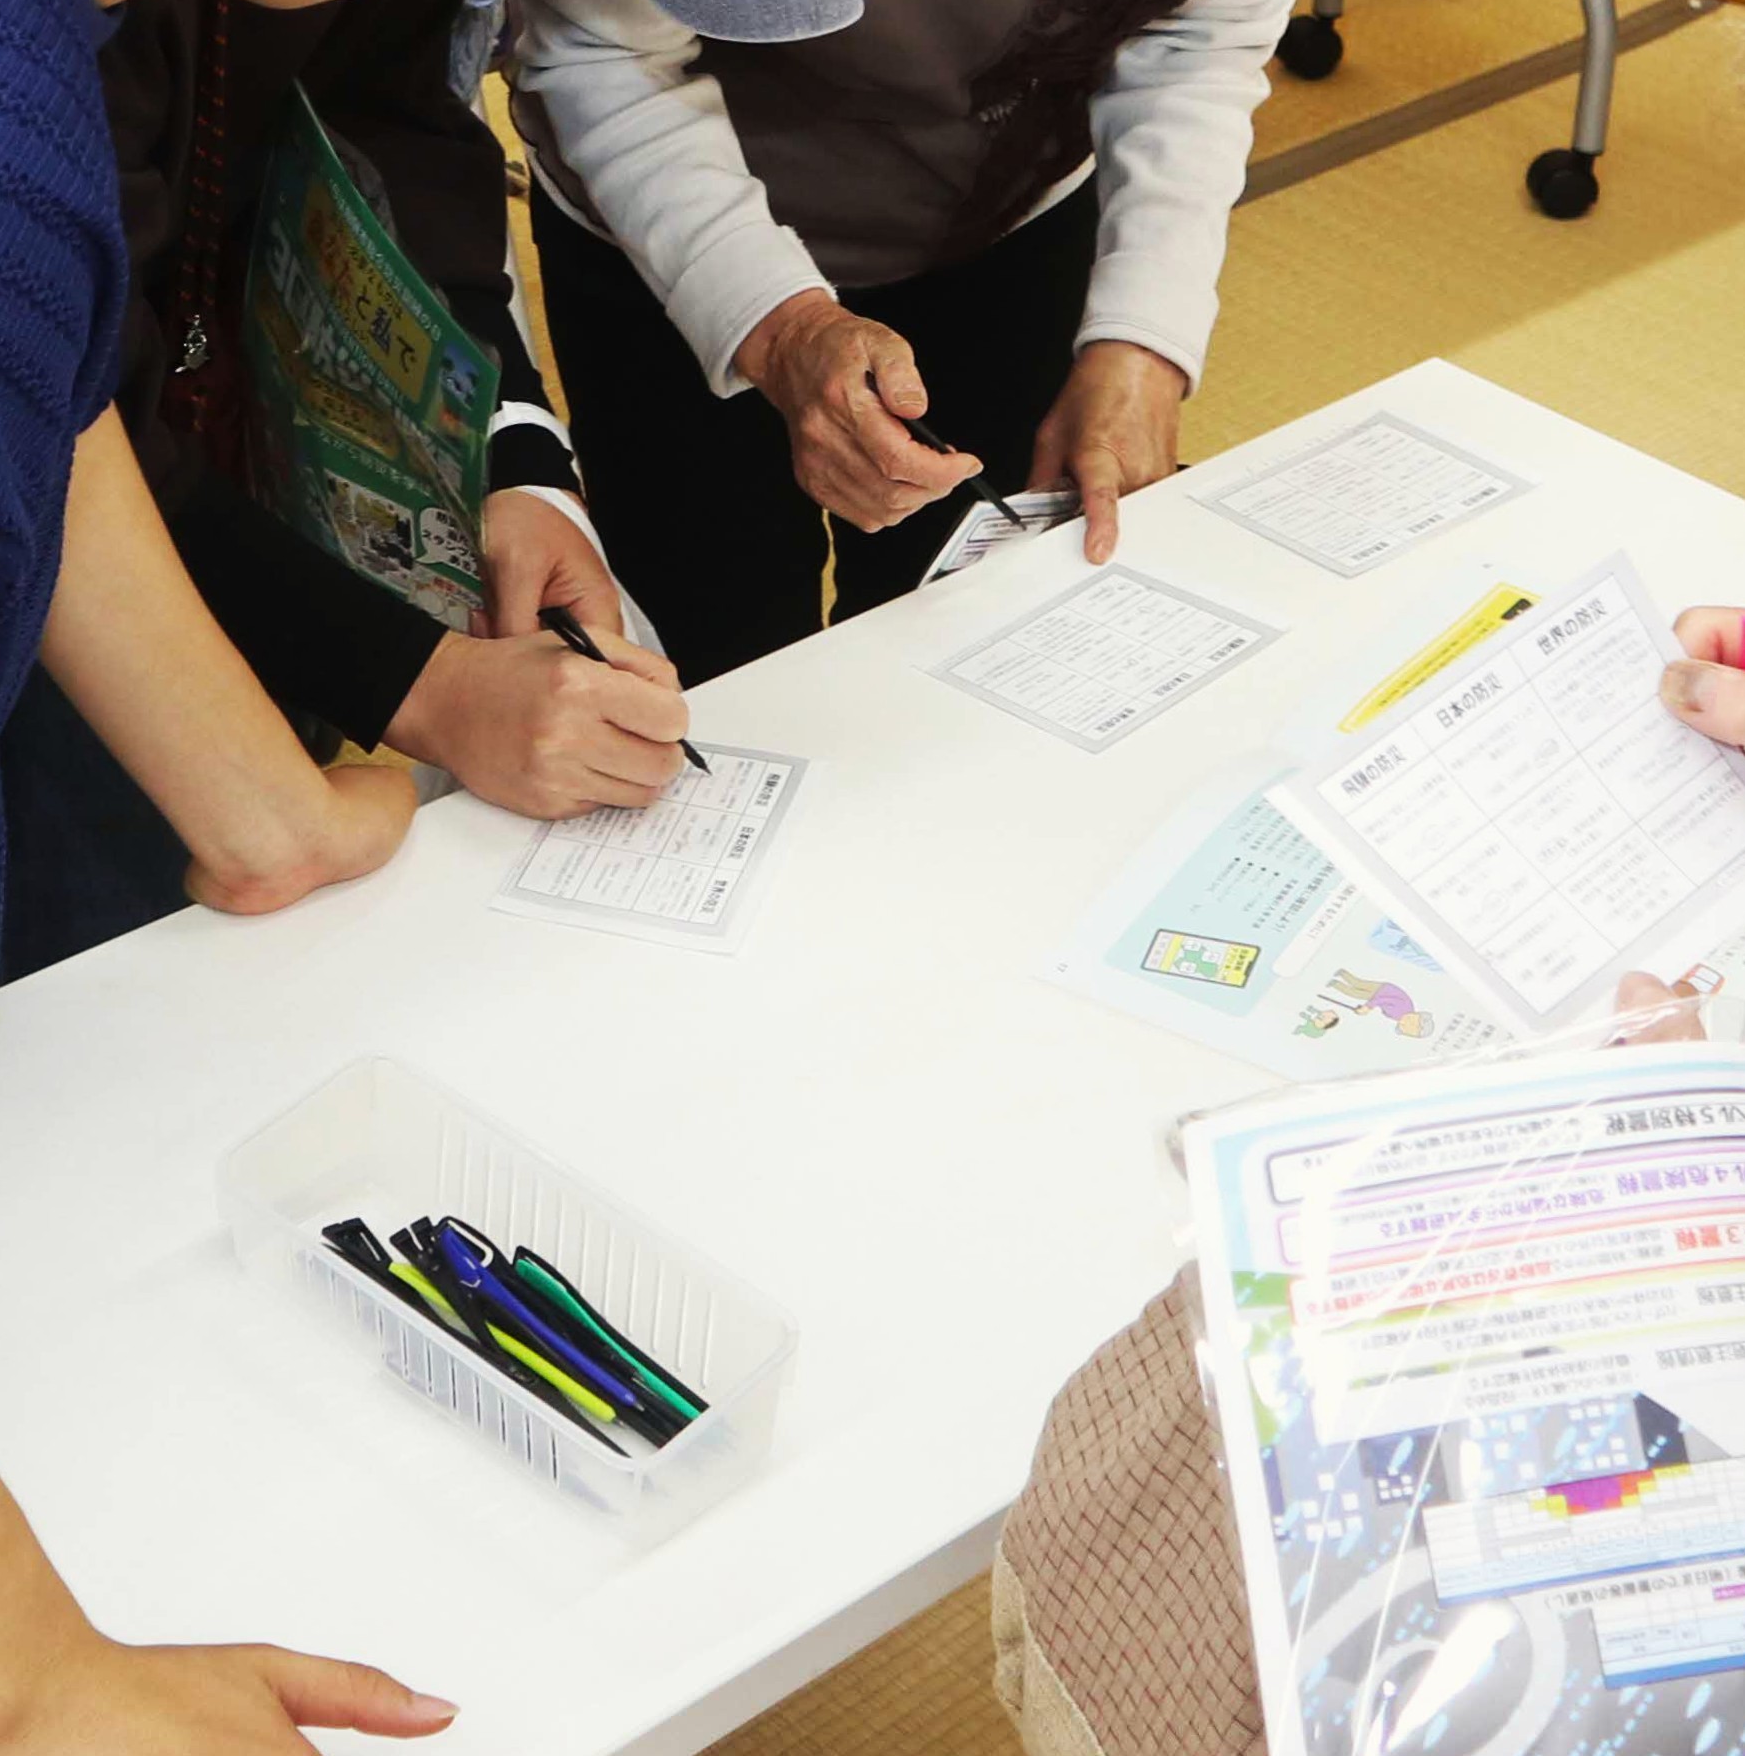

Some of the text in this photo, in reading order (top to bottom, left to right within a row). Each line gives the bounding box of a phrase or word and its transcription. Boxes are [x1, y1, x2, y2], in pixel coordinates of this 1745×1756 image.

[1536, 598, 1609, 656] 世界の防災
[1436, 671, 1503, 728] 日本の防災
